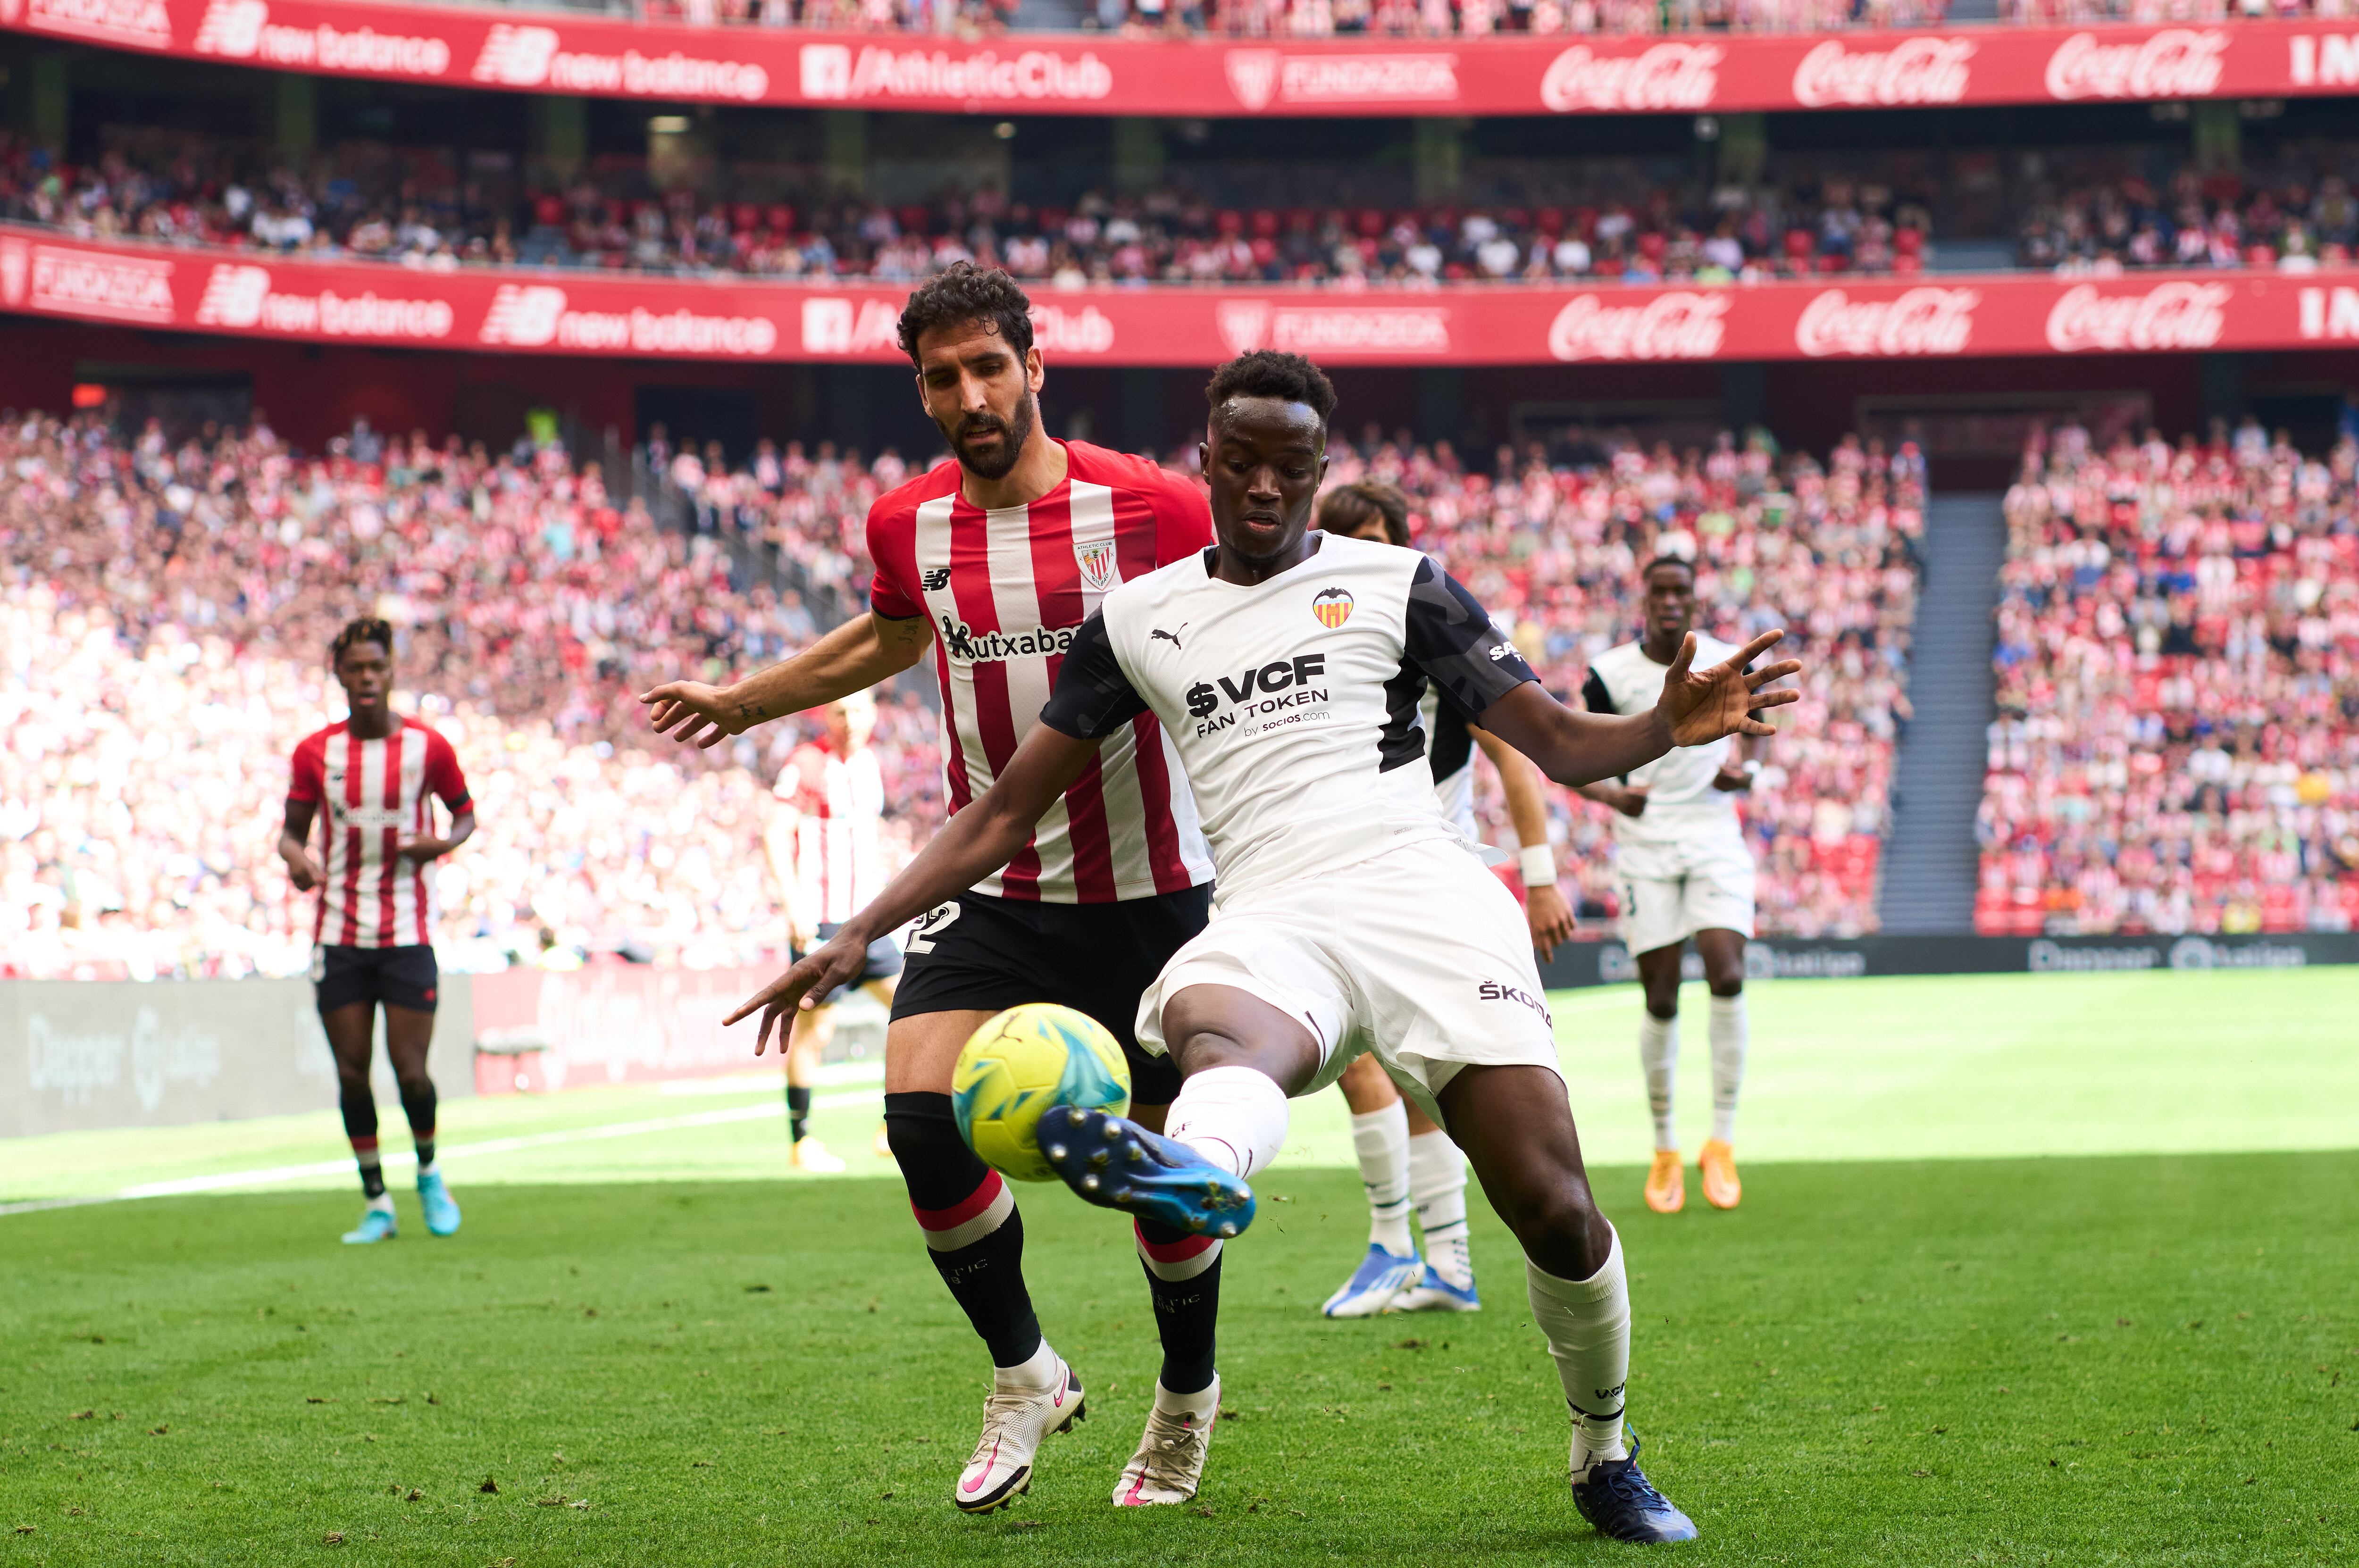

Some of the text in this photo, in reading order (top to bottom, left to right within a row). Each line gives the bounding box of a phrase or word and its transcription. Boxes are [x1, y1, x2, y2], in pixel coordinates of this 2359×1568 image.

[318, 23, 450, 75] balance
[623, 49, 769, 100] balance
[319, 290, 453, 338] balance
[630, 307, 778, 354] balance
[1092, 573, 1109, 586] BILBAO
[942, 616, 1079, 659] Kutxaba
[1197, 689, 1329, 738] FAN TOKEN
[1244, 727, 1258, 737] by
[1479, 981, 1553, 1032] ŠKODA
